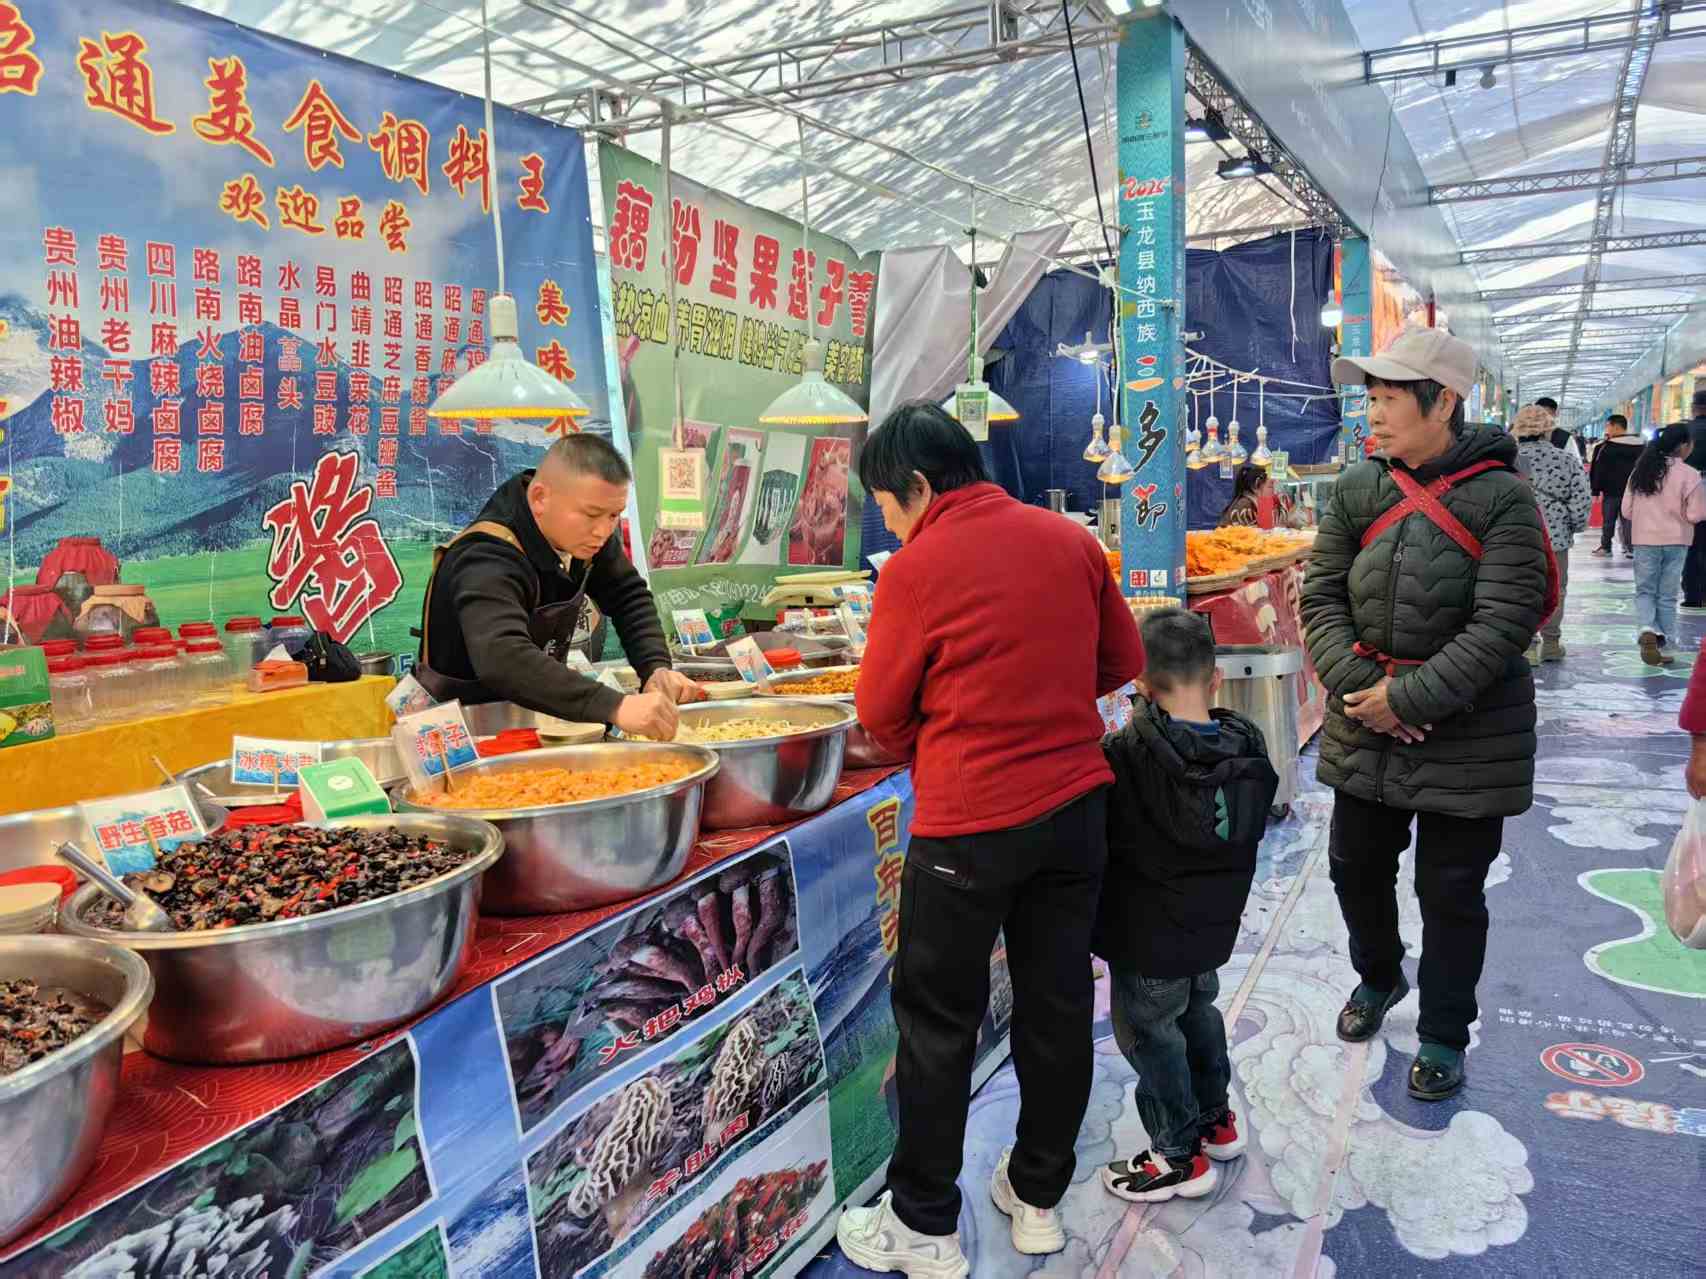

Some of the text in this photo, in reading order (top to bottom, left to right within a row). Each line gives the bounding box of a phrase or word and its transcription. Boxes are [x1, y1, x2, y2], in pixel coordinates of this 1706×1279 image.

[220, 172, 413, 252] 欢迎品尝
[1136, 201, 1157, 343] 玉龙县纳西族
[44, 226, 85, 433] 贵州油辣椒
[98, 235, 135, 434] 贵州老干妈
[146, 240, 183, 473] 四川麻辣卤腐
[193, 248, 225, 473] 路南火烧卤腐
[238, 255, 265, 435] 路南油卤腐
[312, 265, 338, 436] 易门水豆豉
[347, 270, 372, 435] 曲靖韭菜花
[97, 809, 195, 849] 野生香菇
